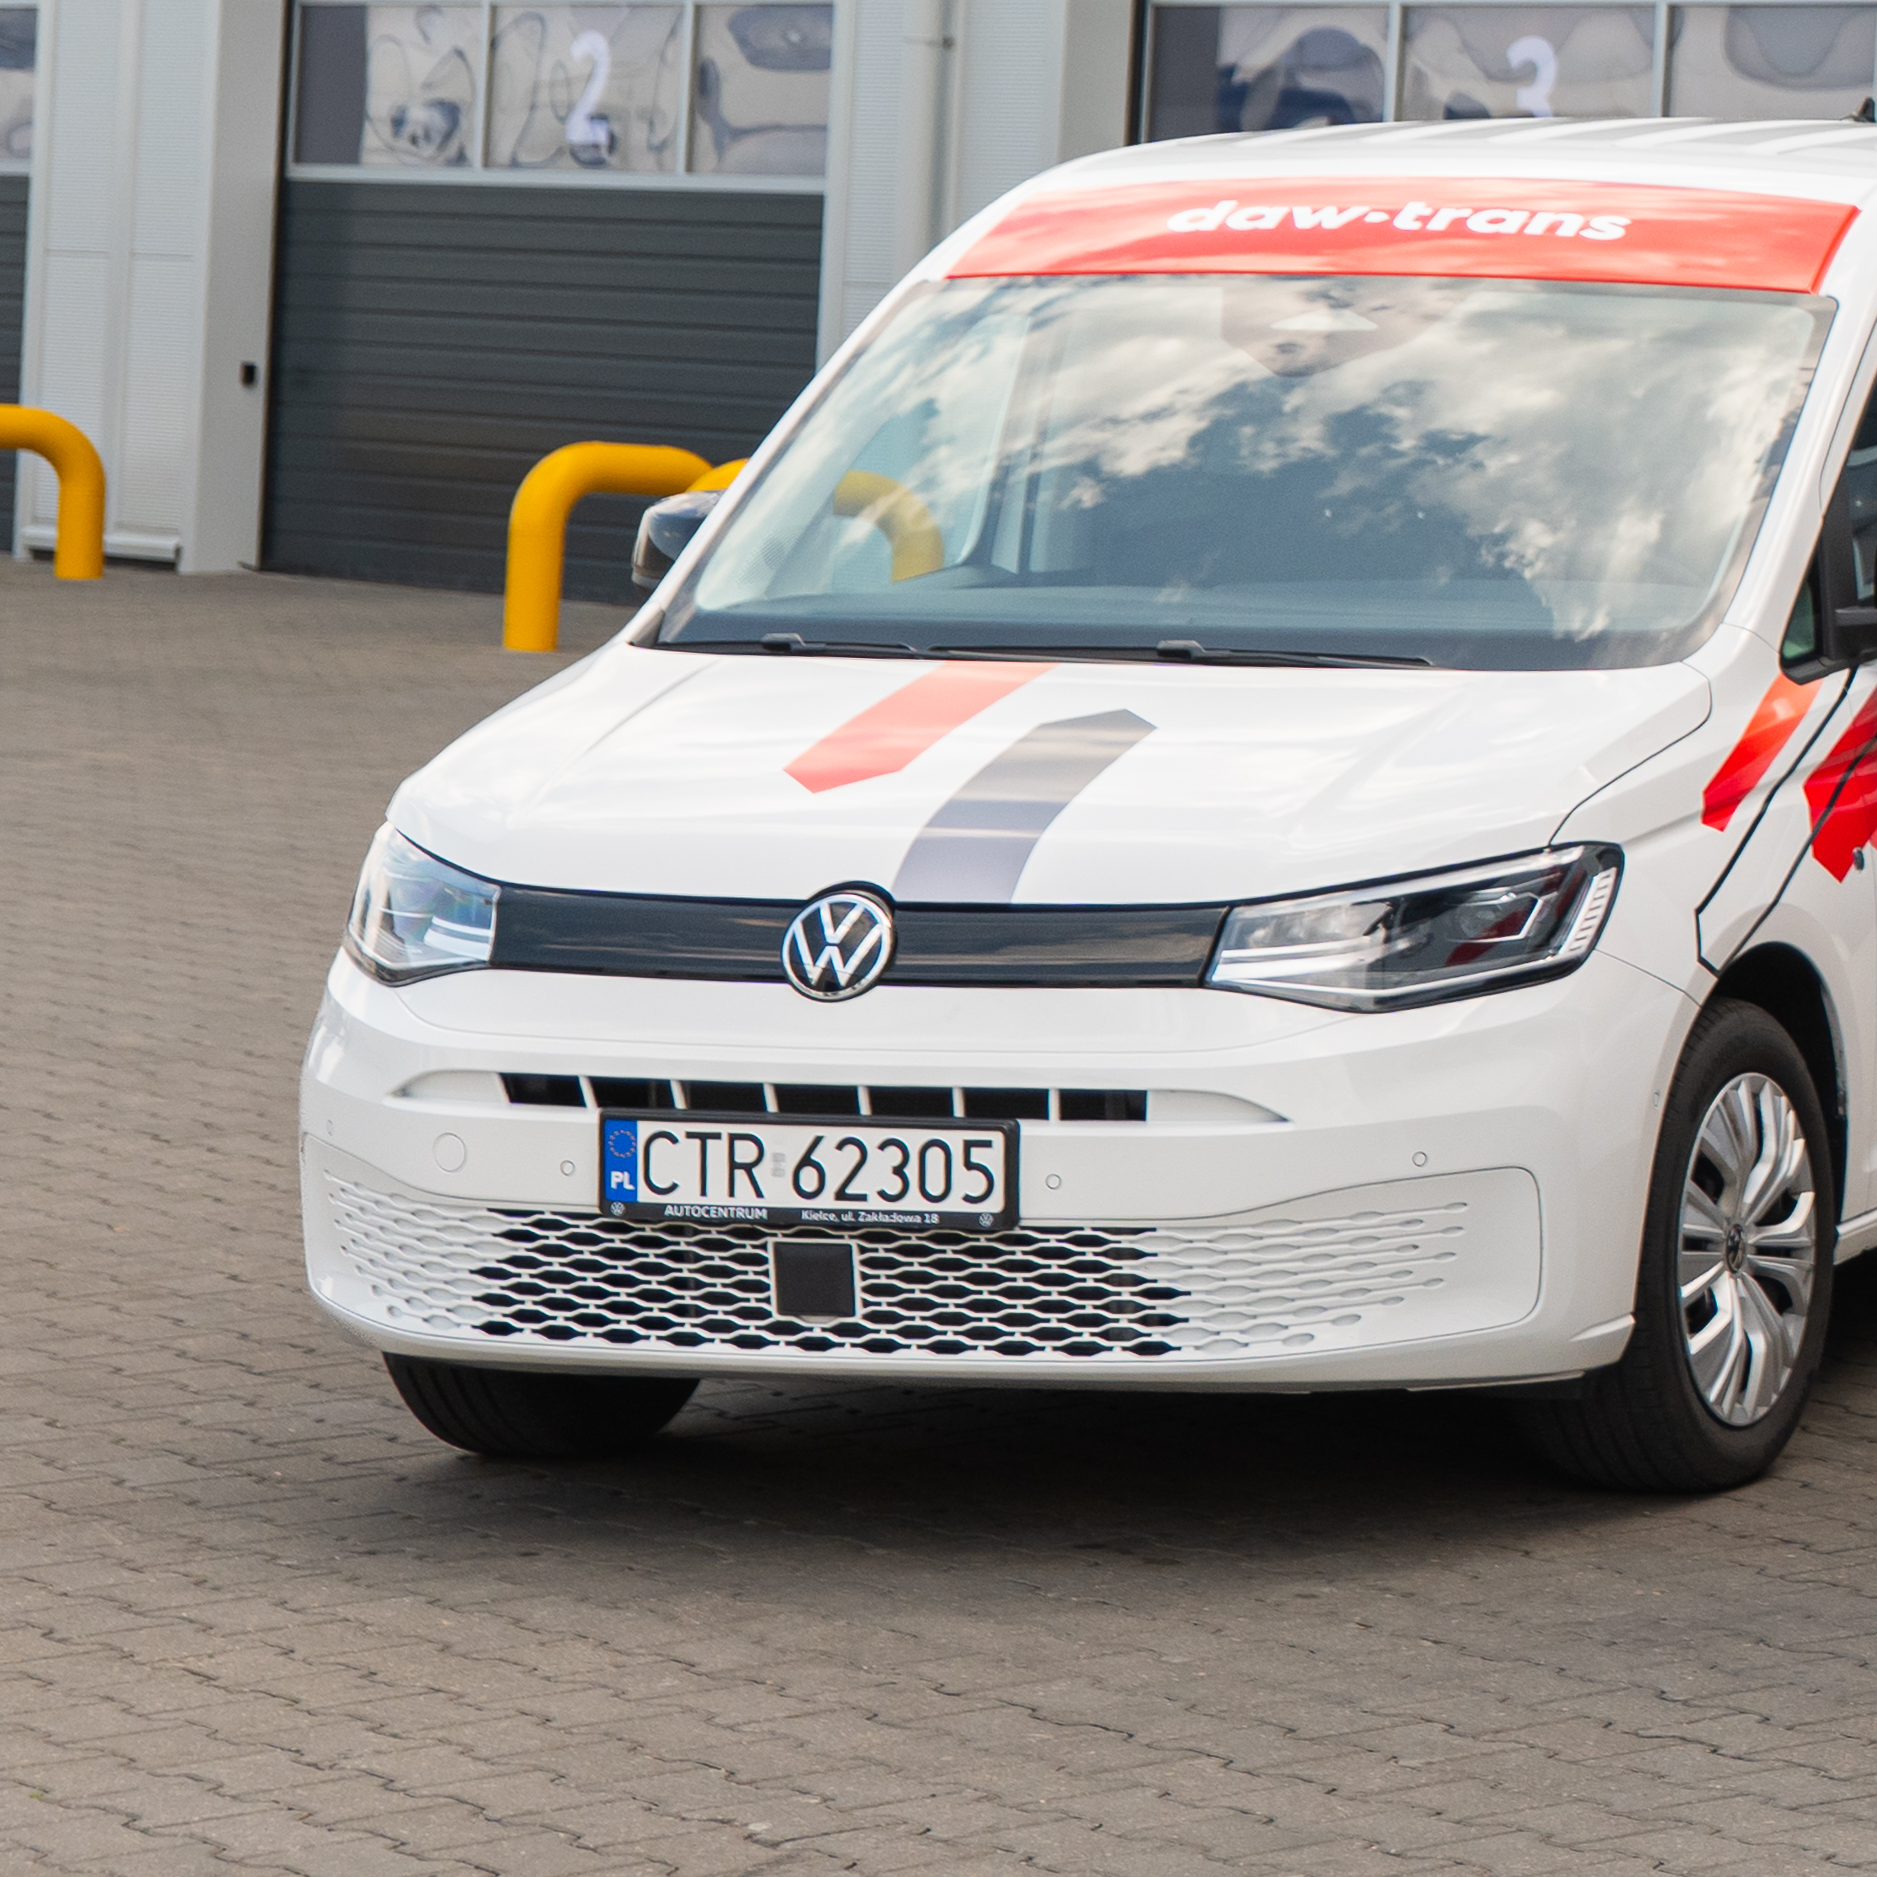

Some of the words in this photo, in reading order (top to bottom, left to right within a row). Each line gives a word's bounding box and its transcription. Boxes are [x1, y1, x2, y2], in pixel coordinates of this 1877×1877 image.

[565, 29, 612, 145] 2
[1506, 35, 1560, 119] 3
[610, 1171, 635, 1191] PL
[642, 1129, 765, 1198] CTR
[791, 1134, 996, 1204] 62305
[664, 1204, 768, 1220] AUTOCENTRUM
